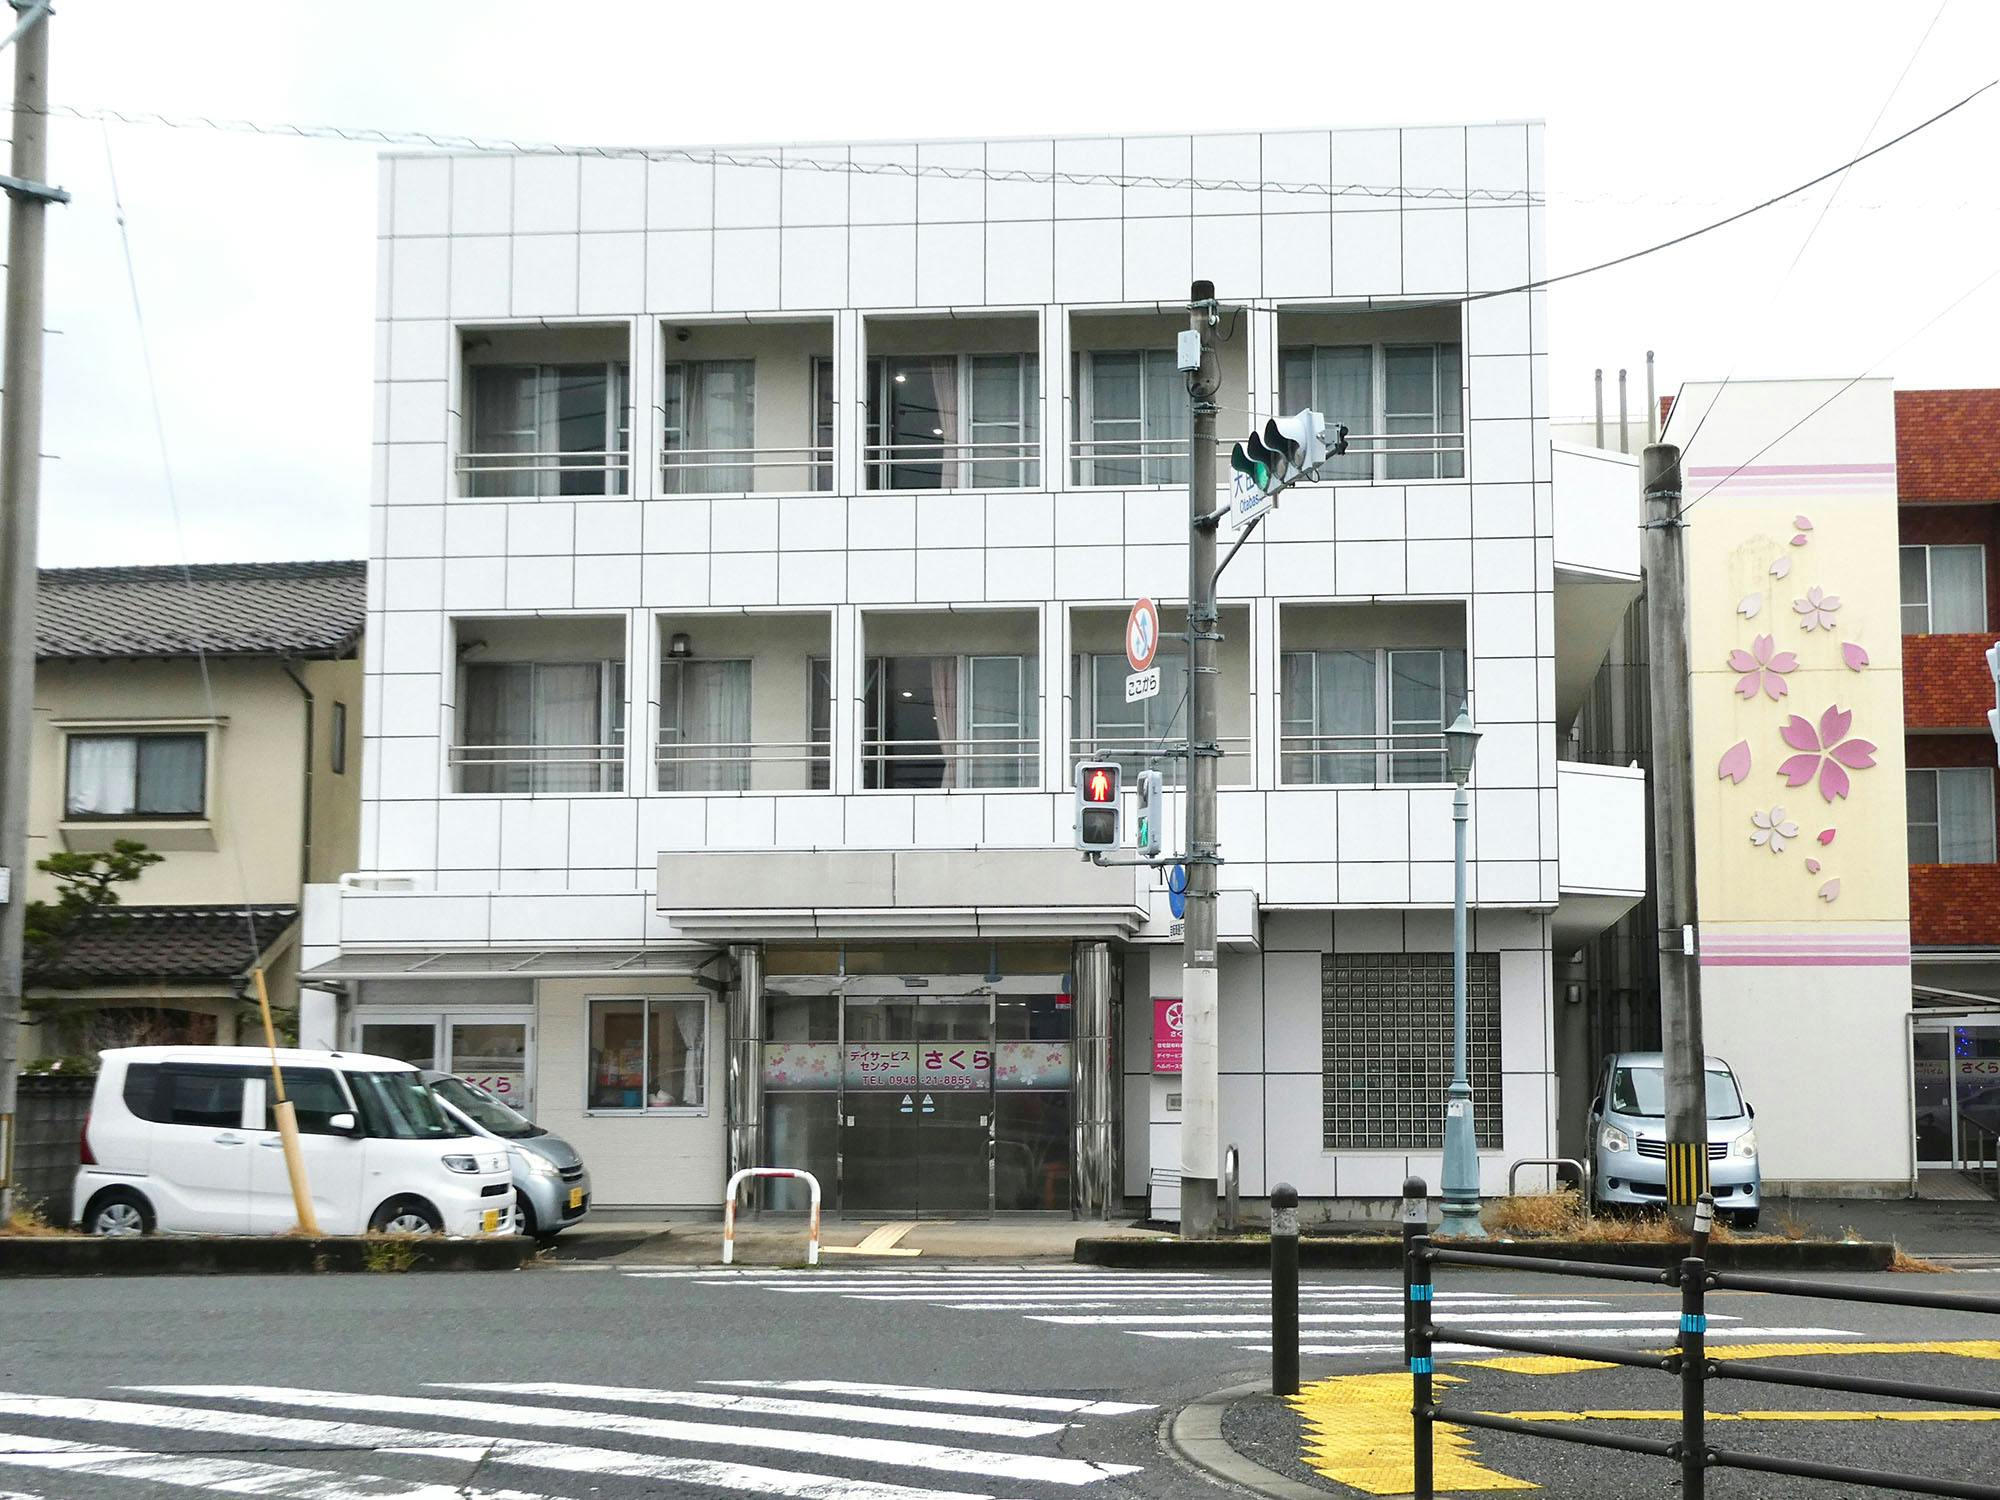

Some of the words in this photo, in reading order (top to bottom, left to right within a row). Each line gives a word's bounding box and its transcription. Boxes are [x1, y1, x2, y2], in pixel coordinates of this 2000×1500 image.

[1128, 675, 1157, 696] ここから
[850, 1051, 910, 1061] デイサービス
[925, 1050, 991, 1070] さくら
[860, 1062, 901, 1072] センター
[1962, 1062, 1999, 1074] さくら
[863, 1076, 884, 1085] TEL
